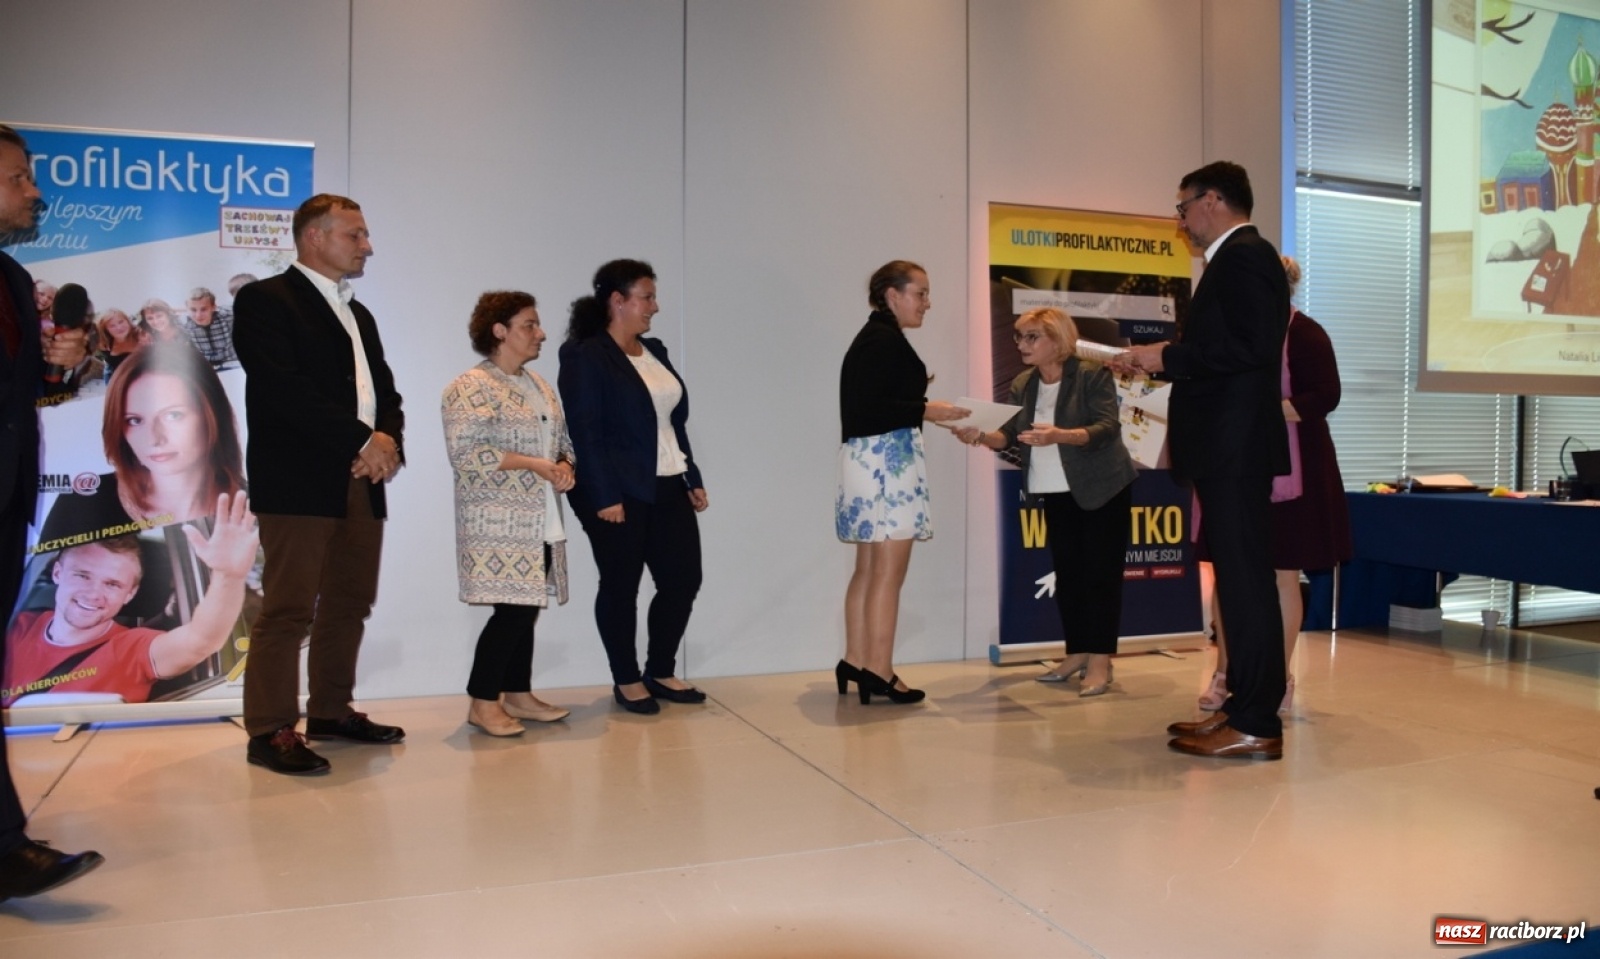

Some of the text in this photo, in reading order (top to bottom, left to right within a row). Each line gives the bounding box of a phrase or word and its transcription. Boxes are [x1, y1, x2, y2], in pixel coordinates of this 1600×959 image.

[28, 145, 290, 205] rofilaktyka
[31, 195, 144, 231] ajlepszym
[8, 227, 88, 256] ydaniu
[1011, 229, 1174, 256] ULOTKIPROFILAKTYCZNE.PL
[1133, 325, 1164, 335] SZUKAJ
[1559, 350, 1590, 362] Natalia
[1, 667, 97, 699] DLA KIEROWCÓW
